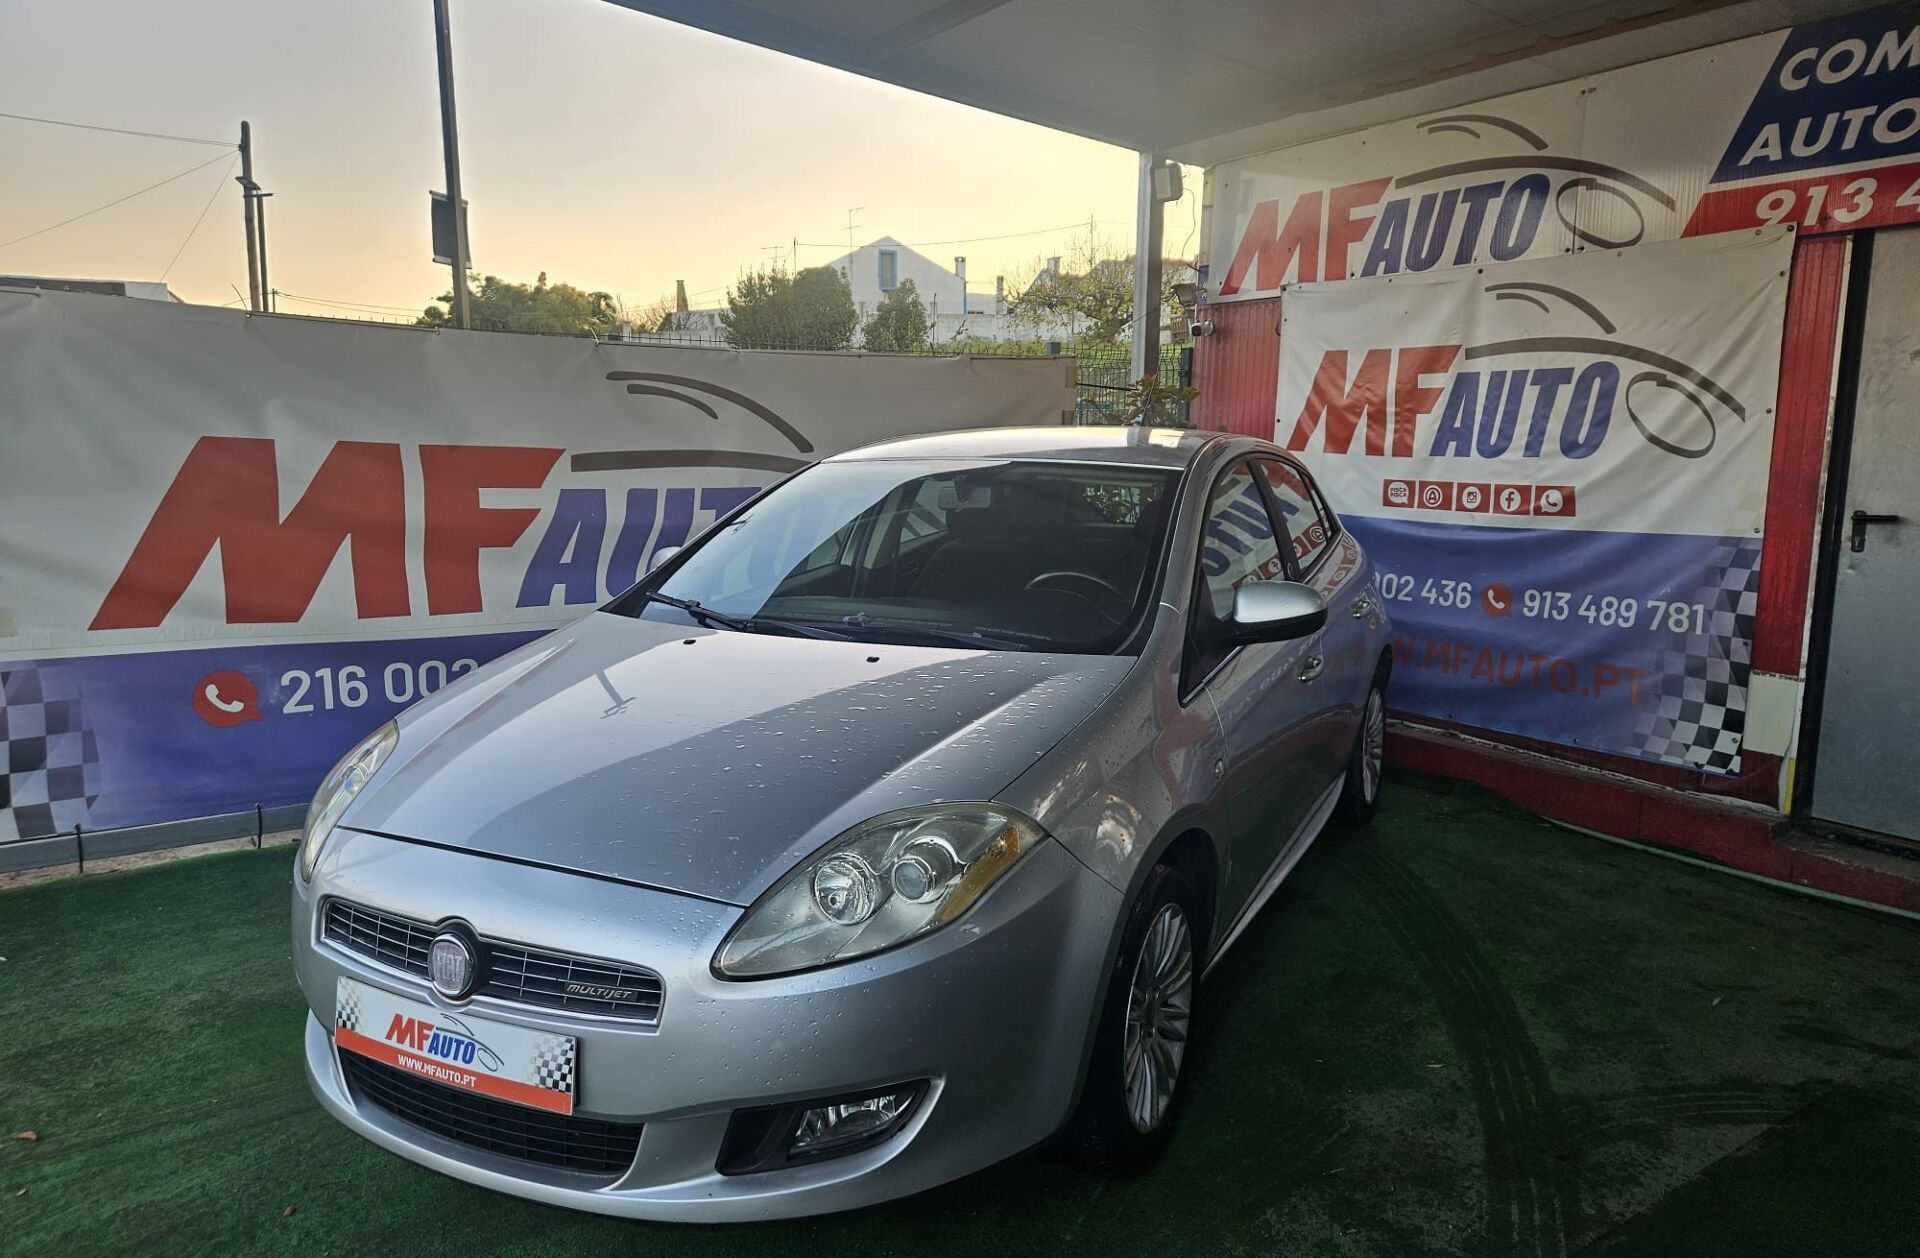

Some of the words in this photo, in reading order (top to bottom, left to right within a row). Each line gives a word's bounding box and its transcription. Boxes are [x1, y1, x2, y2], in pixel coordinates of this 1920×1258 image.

[1756, 178, 1878, 227] 913
[1374, 572, 1415, 602] 02
[1421, 578, 1473, 609] 436
[1523, 589, 1572, 621] 913
[1578, 594, 1638, 628] 489
[1647, 600, 1705, 635] 781
[280, 665, 369, 714] 216
[435, 950, 463, 982] FIAT
[566, 984, 633, 999] MULTIJET
[398, 1054, 477, 1088] WWW.MFAUTO.PT
